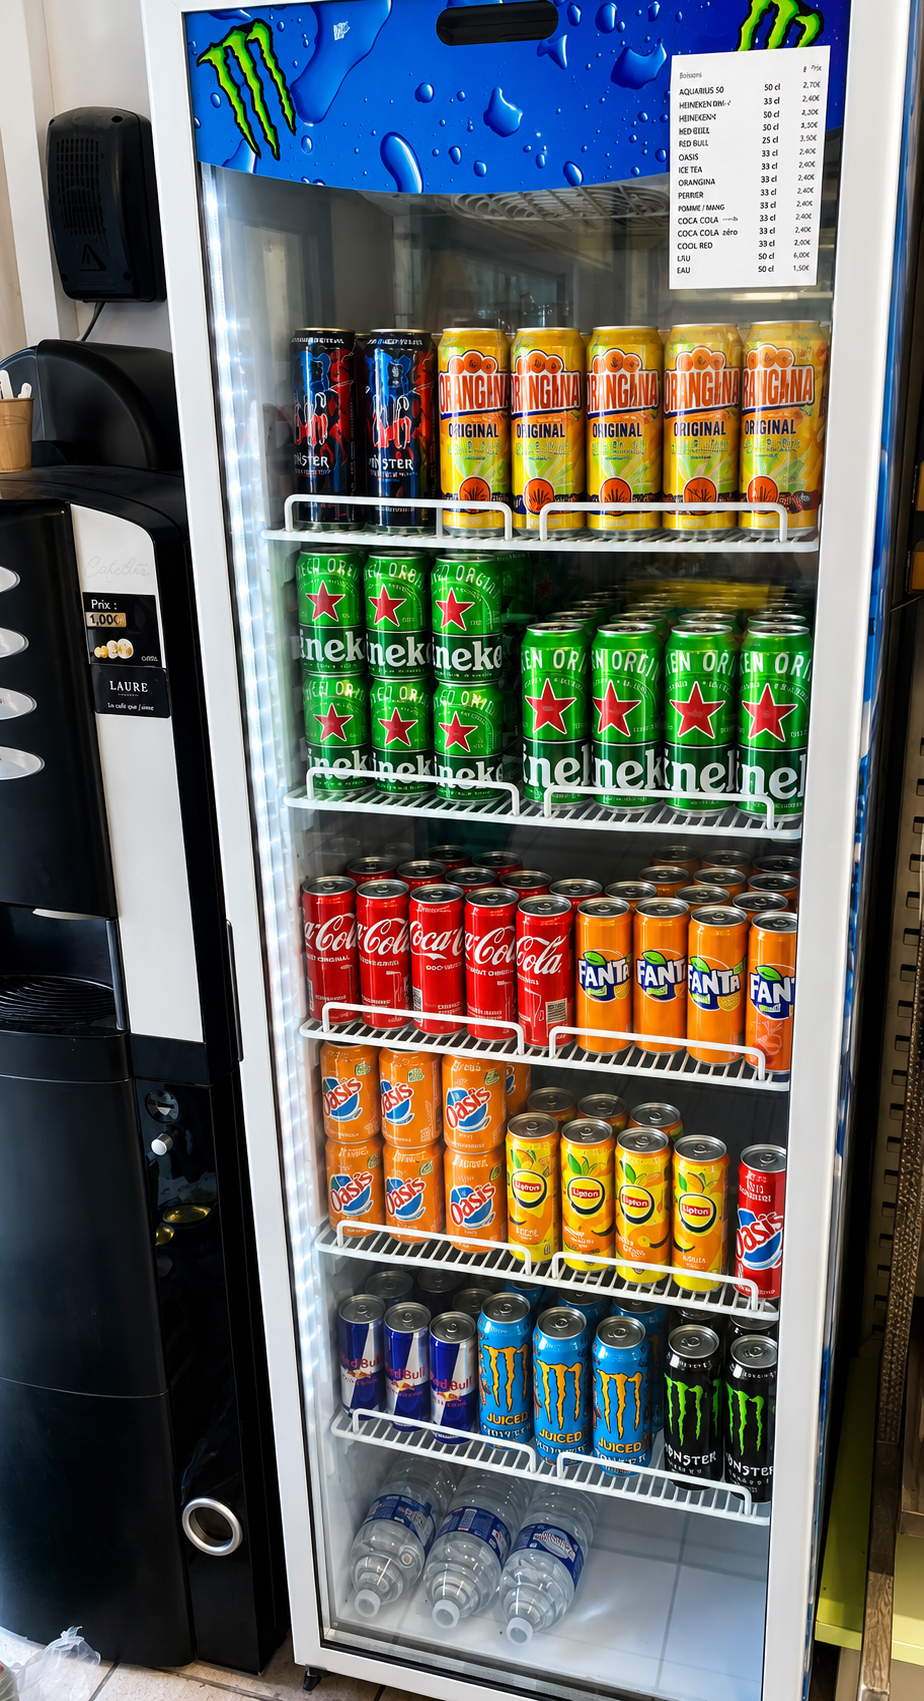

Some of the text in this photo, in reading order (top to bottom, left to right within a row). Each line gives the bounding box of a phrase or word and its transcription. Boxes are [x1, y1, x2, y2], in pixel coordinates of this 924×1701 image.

[773, 110, 780, 118] cl
[679, 140, 692, 148] RED
[762, 136, 771, 144] 25
[678, 153, 699, 161] OASIS
[678, 166, 688, 174] ICE
[772, 162, 778, 170] cl
[678, 178, 715, 186] ORANGINA
[770, 188, 776, 196] cl
[678, 204, 701, 212] POMME
[699, 216, 718, 224] COLA
[760, 214, 768, 222] 33
[721, 228, 737, 236] zéro
[677, 242, 697, 250] COOL
[677, 266, 690, 274] EAU
[768, 264, 774, 272] cl
[448, 423, 499, 438] ORIGINAL
[517, 423, 566, 438] ORIGINAL
[592, 422, 642, 438] ORIGINAL
[673, 420, 726, 437] ORIGINAL
[745, 419, 797, 435] ORIGINAL
[91, 599, 111, 609] Prix
[109, 680, 149, 693] LAURE
[750, 973, 795, 1004] FAN
[445, 1086, 492, 1129] Oasis
[329, 1171, 374, 1214] Oasis
[385, 1176, 426, 1218] Oasis
[449, 1182, 496, 1227] Oasis
[682, 1204, 709, 1216] Lipton
[403, 1367, 425, 1380] Bull
[450, 1376, 472, 1391] Bull
[486, 1411, 528, 1426] JUICED
[539, 1428, 582, 1443] JUICED
[598, 1437, 642, 1454] JUICED
